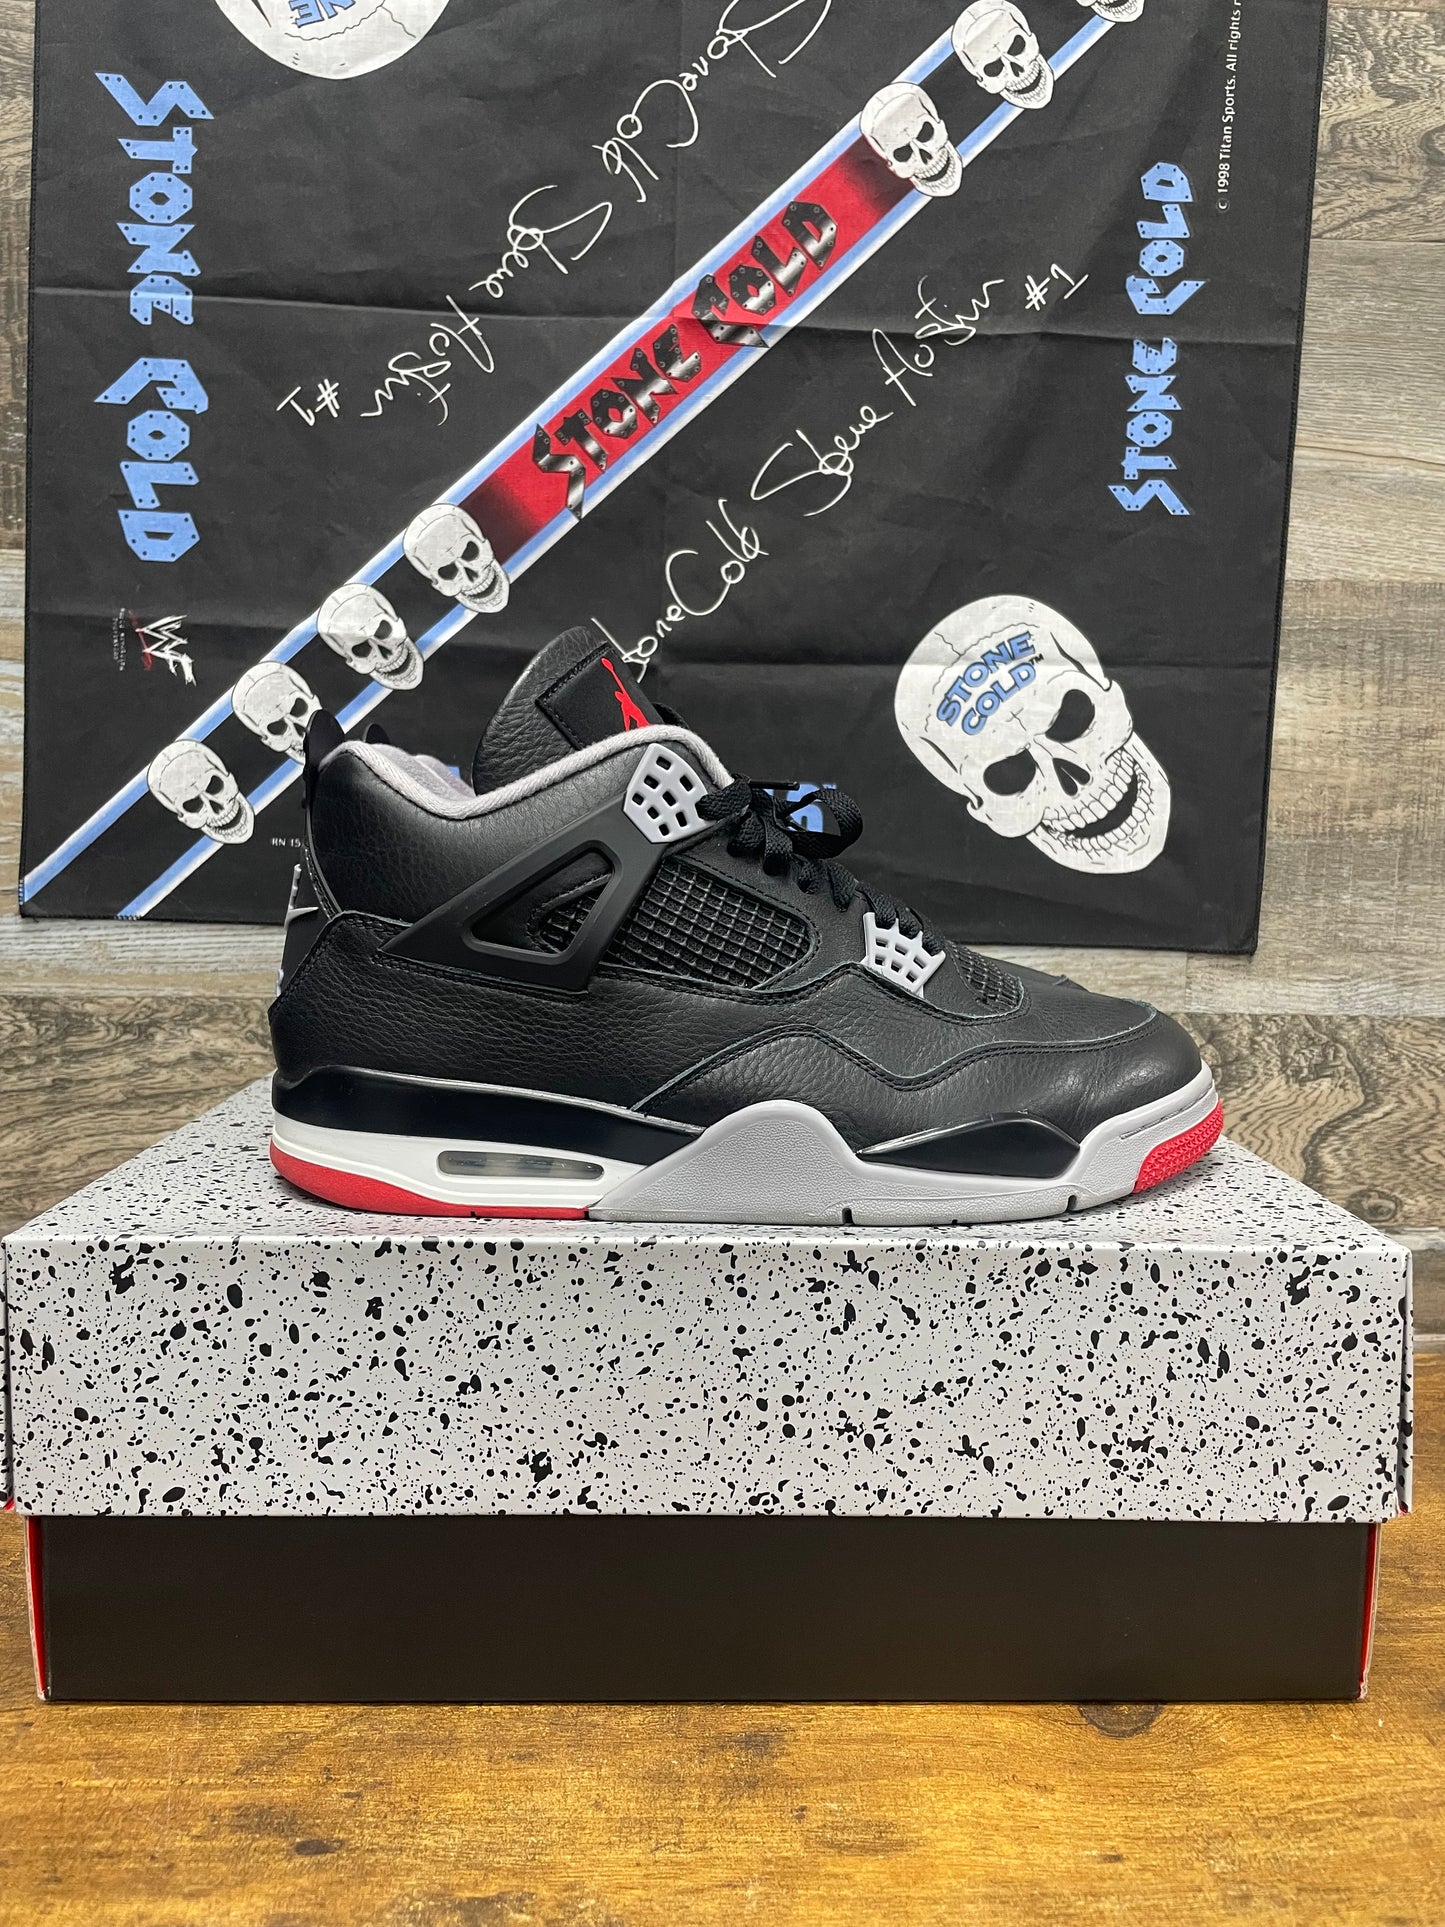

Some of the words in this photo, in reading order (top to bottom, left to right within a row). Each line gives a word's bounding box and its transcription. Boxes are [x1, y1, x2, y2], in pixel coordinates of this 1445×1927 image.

[1225, 54, 1237, 71] All
[1228, 9, 1242, 51] rights
[1219, 126, 1233, 160] Titan
[1222, 75, 1236, 123] Sports.
[94, 72, 214, 325] STONE
[1217, 162, 1231, 193] 1998
[1125, 162, 1206, 315] COLD
[275, 378, 340, 427] #1
[532, 323, 702, 520] STONE
[691, 200, 838, 348] COLD
[94, 357, 208, 562] COLD
[591, 604, 686, 684] tone
[1024, 263, 1089, 311] #1
[1108, 336, 1190, 516] STONE
[936, 630, 1036, 727] STONE
